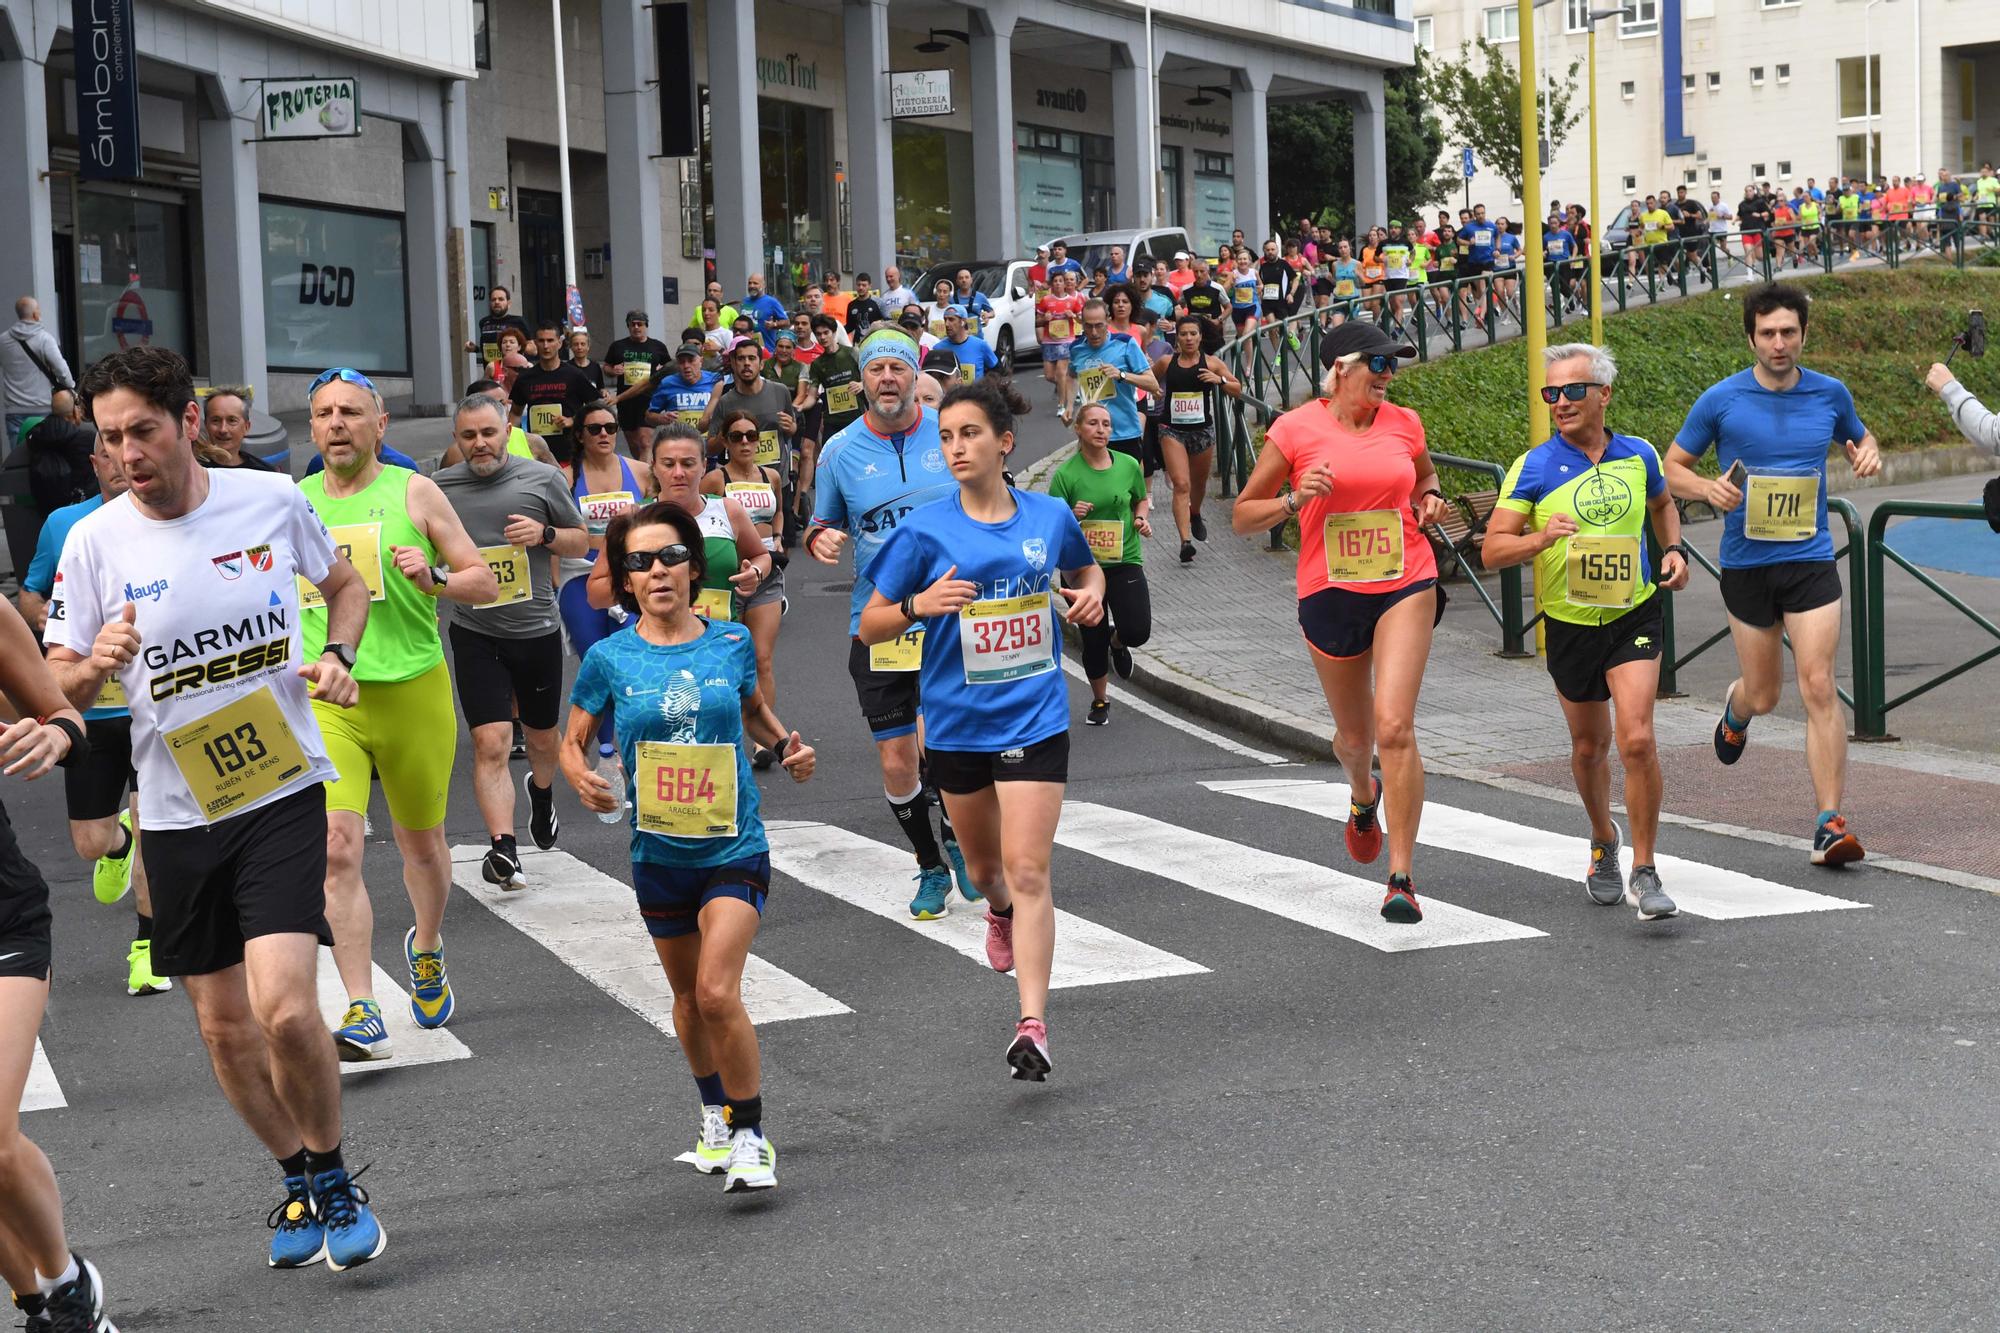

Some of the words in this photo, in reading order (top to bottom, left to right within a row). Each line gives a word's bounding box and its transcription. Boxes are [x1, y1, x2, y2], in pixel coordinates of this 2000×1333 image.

[299, 263, 355, 308] DCD
[877, 346, 897, 354] Club
[832, 391, 850, 404] 1510
[1174, 400, 1201, 413] 3044
[733, 492, 771, 508] 3300
[1767, 493, 1801, 517] 1711
[1338, 527, 1391, 558] 1675
[1580, 553, 1631, 582] 1559
[124, 577, 169, 603] Nauga
[143, 608, 286, 671] GARMIN
[973, 613, 1042, 654] 3293
[150, 636, 290, 703] CRESSI
[175, 686, 214, 702] Professional
[215, 682, 235, 693] diving
[203, 722, 268, 778] 193
[244, 768, 256, 778] DE
[259, 755, 280, 771] BENS
[656, 766, 716, 804] 664
